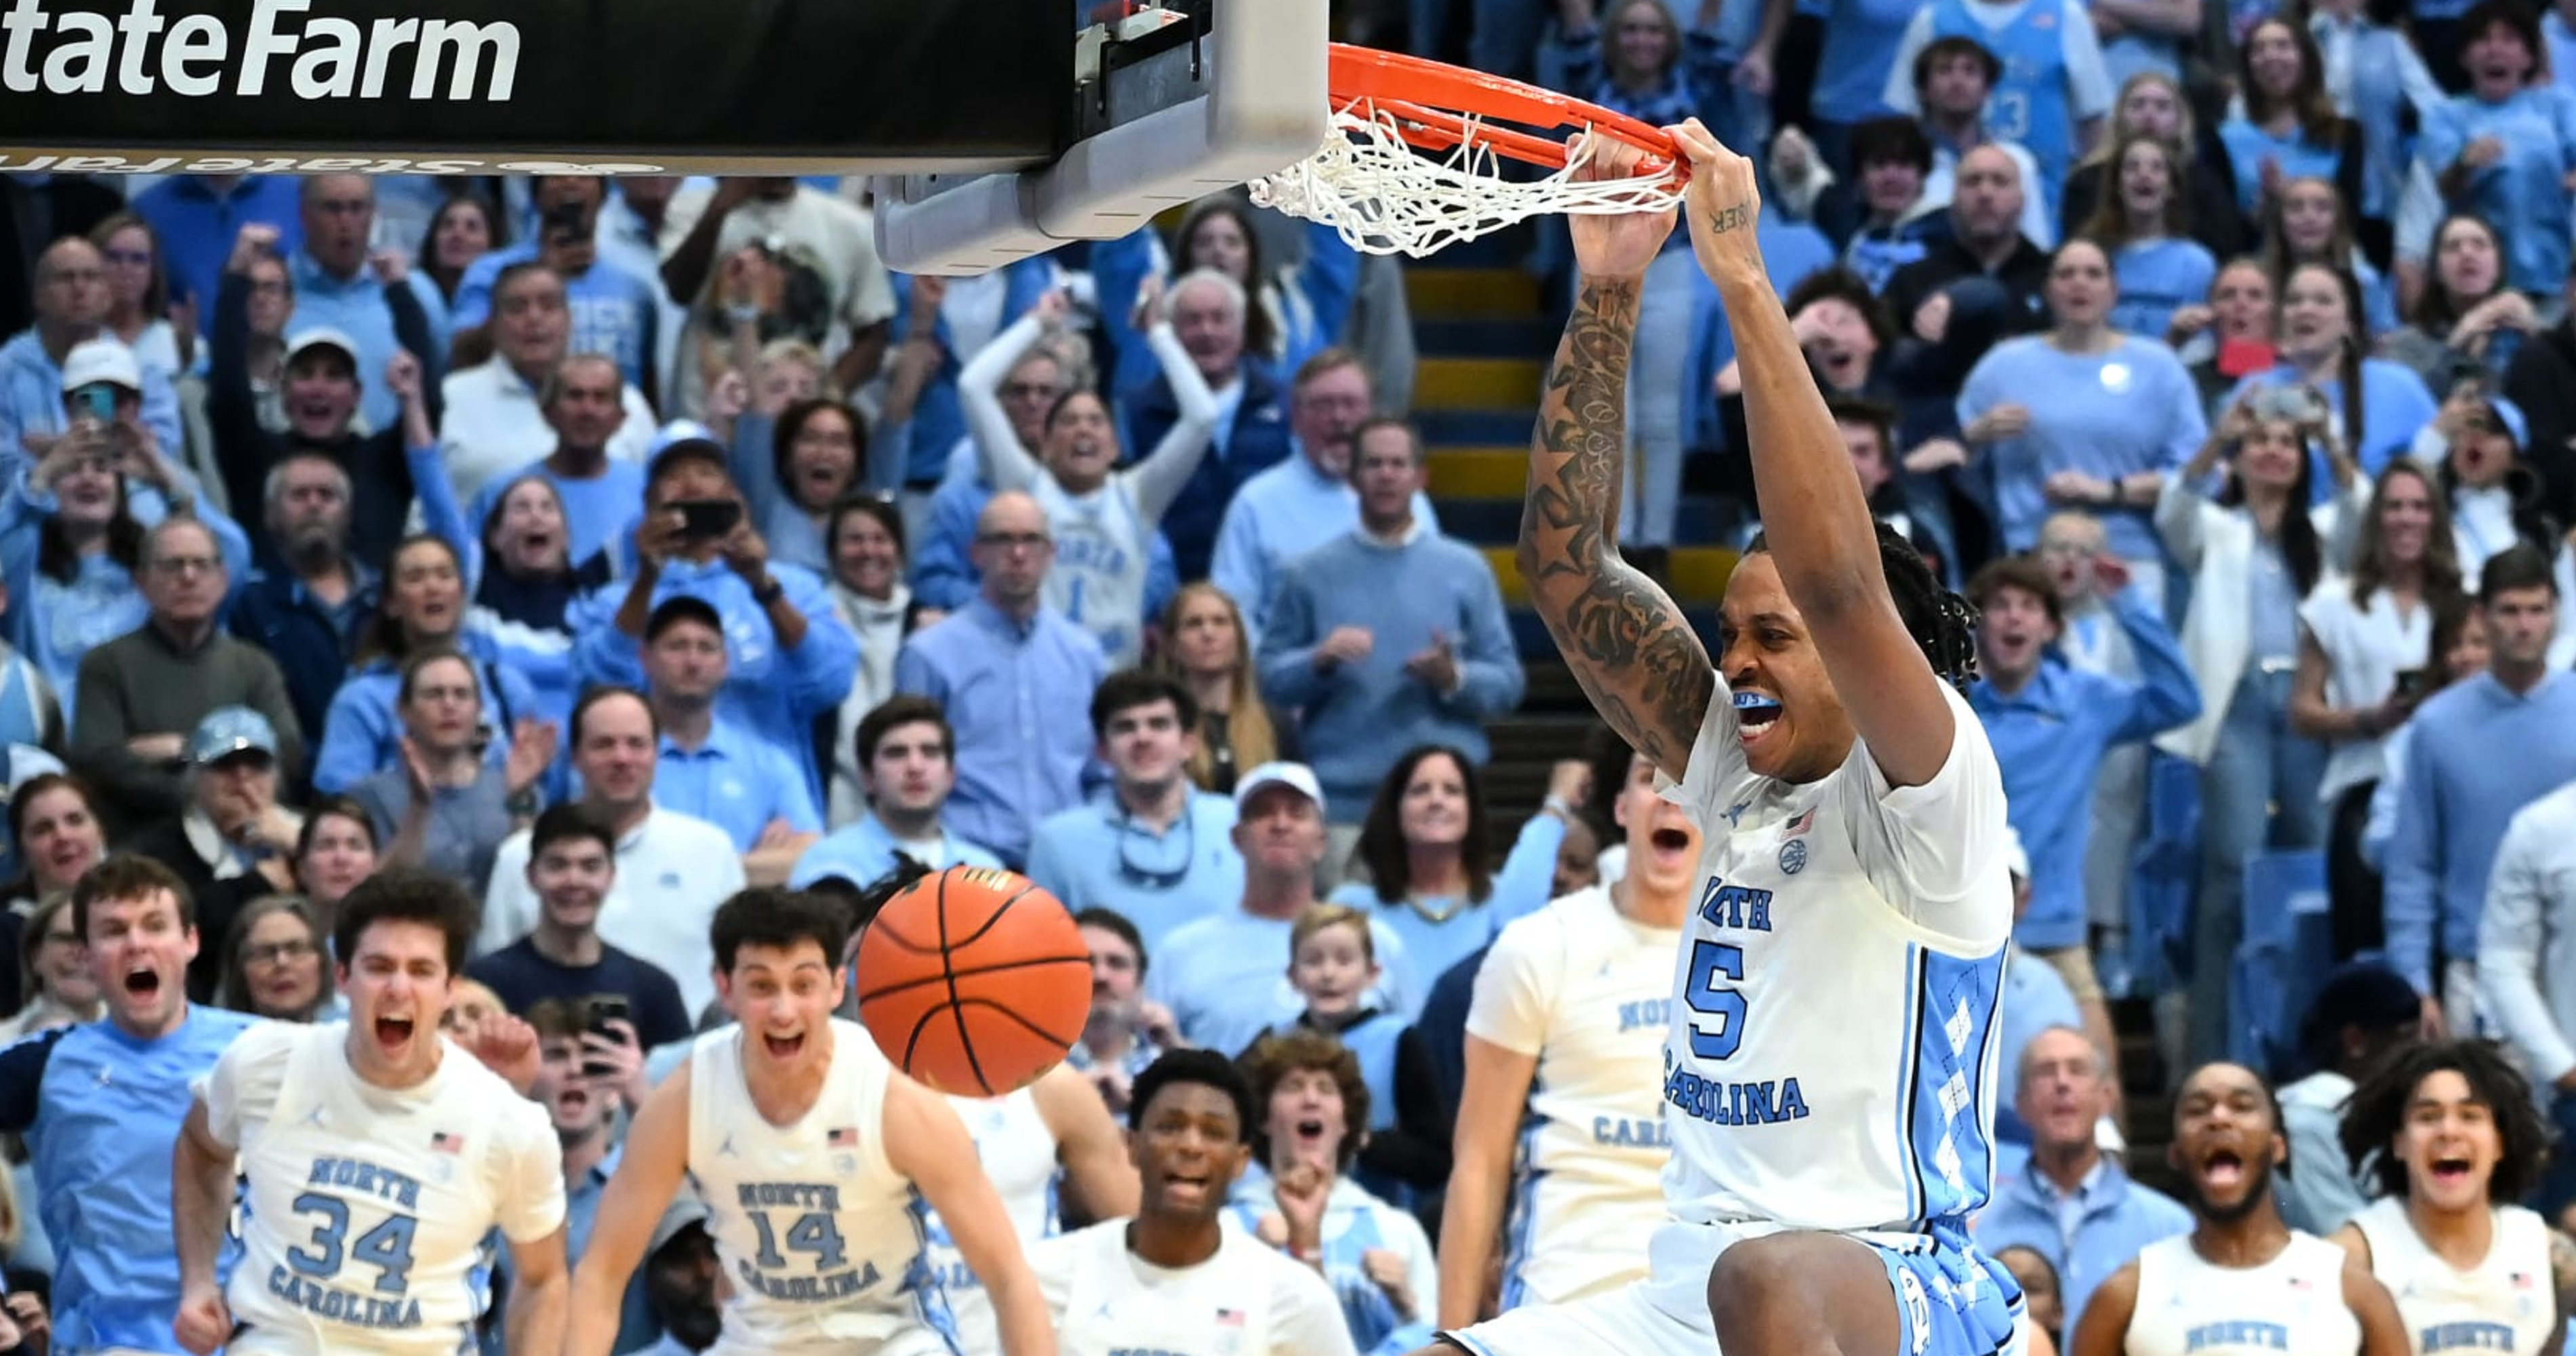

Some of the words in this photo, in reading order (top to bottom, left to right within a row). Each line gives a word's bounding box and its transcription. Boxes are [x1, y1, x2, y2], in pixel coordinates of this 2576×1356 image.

[236, 0, 520, 101] Farm
[0, 155, 183, 173] Far
[186, 157, 485, 174] State
[1685, 939, 1748, 1060] 5
[309, 1157, 420, 1210] NORTH
[738, 1182, 841, 1212] NORTH
[287, 1192, 418, 1294] 34
[746, 1210, 847, 1272] 14
[268, 1265, 422, 1328] CAROLINA
[740, 1260, 882, 1302] CAROLINA
[2186, 1321, 2288, 1353] NORTH
[2422, 1321, 2514, 1354] NORTH
